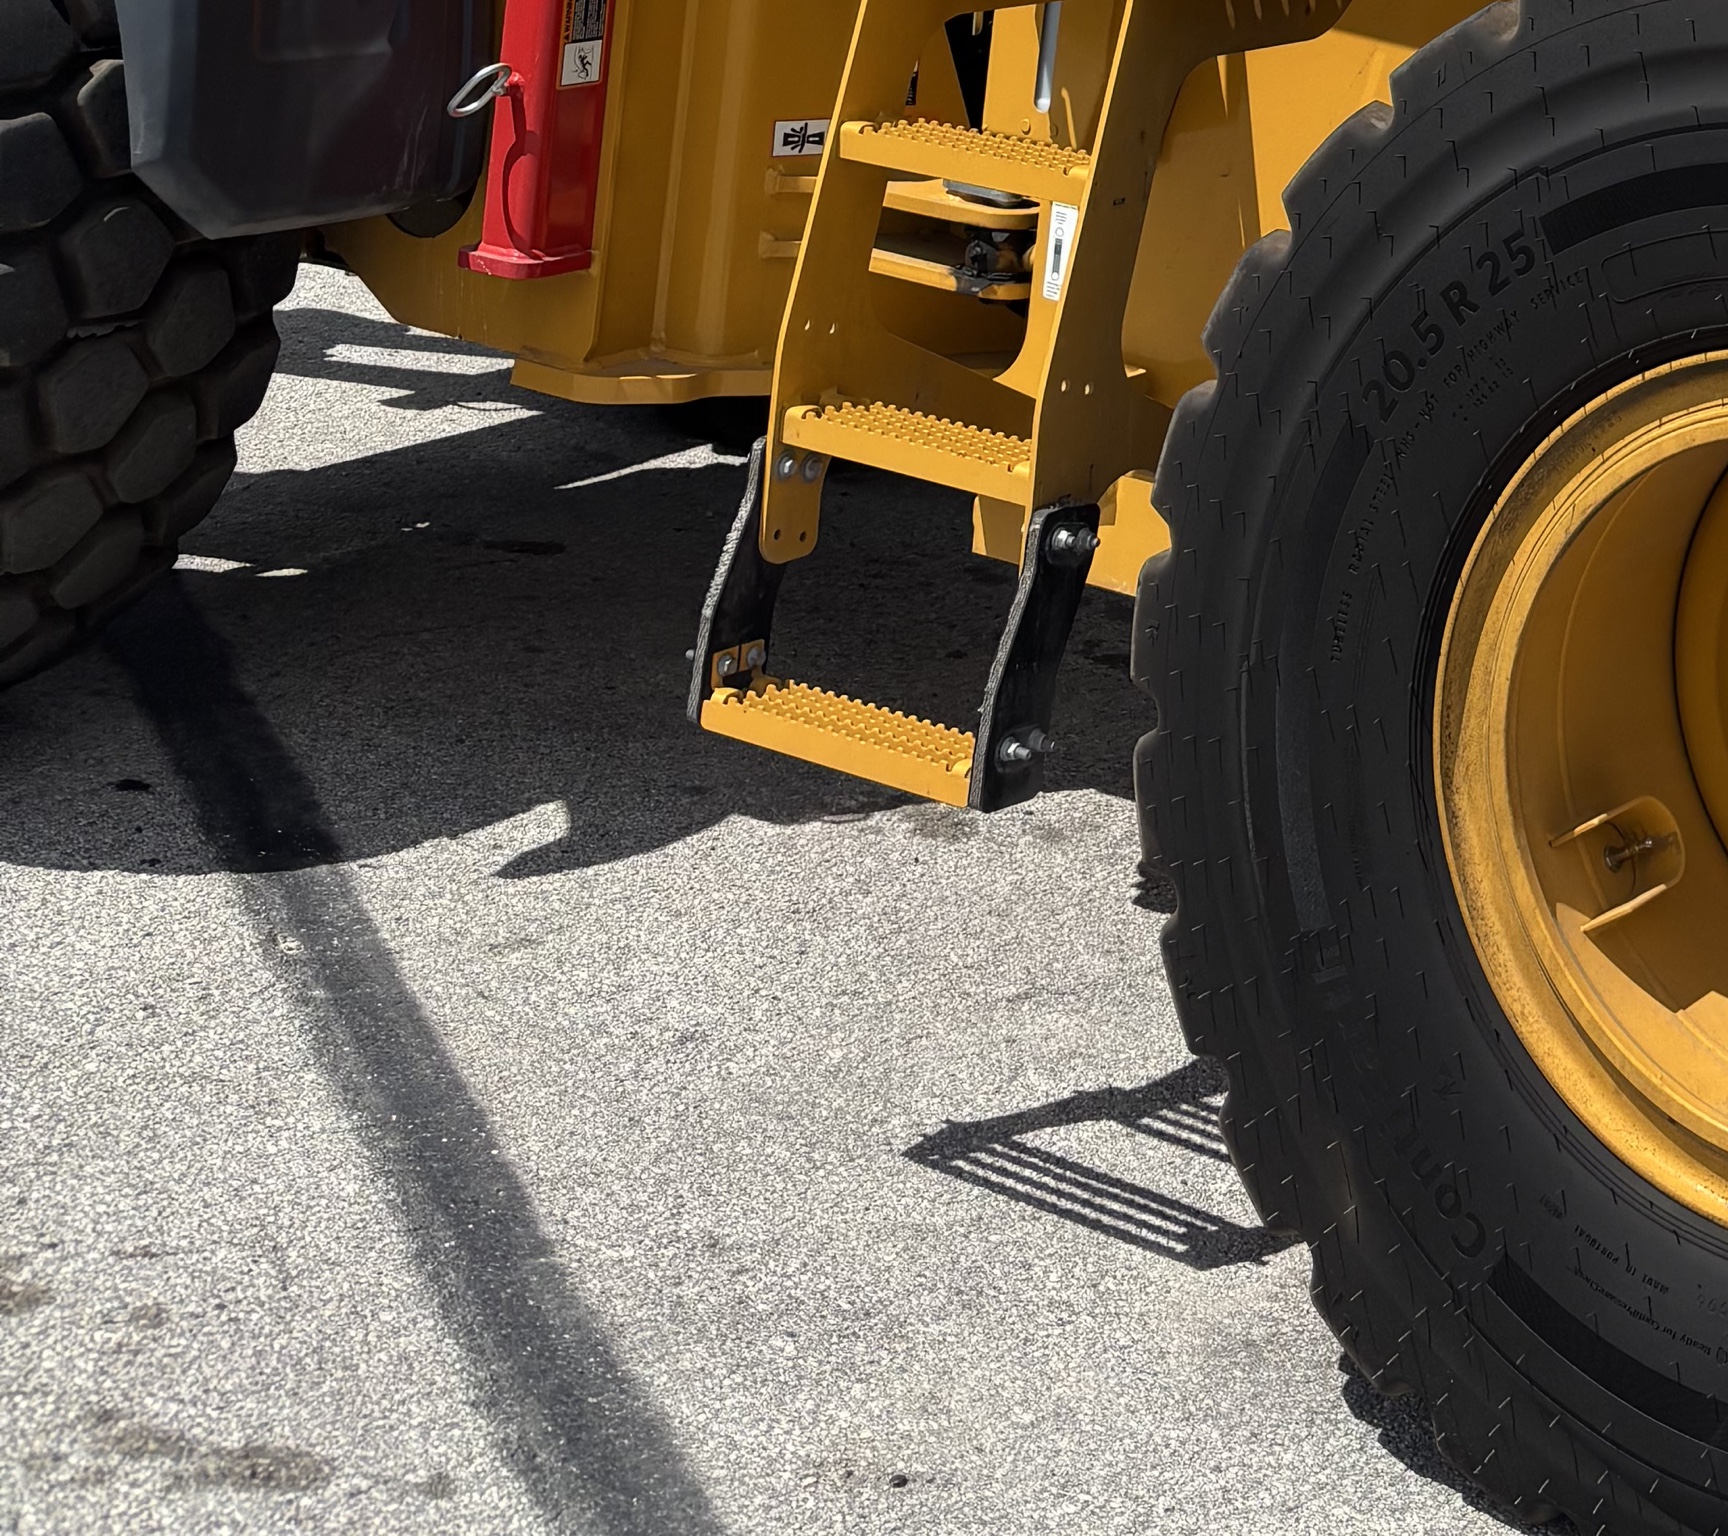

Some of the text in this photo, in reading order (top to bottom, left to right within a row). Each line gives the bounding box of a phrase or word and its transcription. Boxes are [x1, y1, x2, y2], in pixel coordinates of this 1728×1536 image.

[1361, 310, 1446, 425] 20.5
[1439, 280, 1480, 328] R
[1475, 230, 1536, 298] 25
[1442, 363, 1465, 389] FOR
[1466, 309, 1520, 363] HIGHWAY
